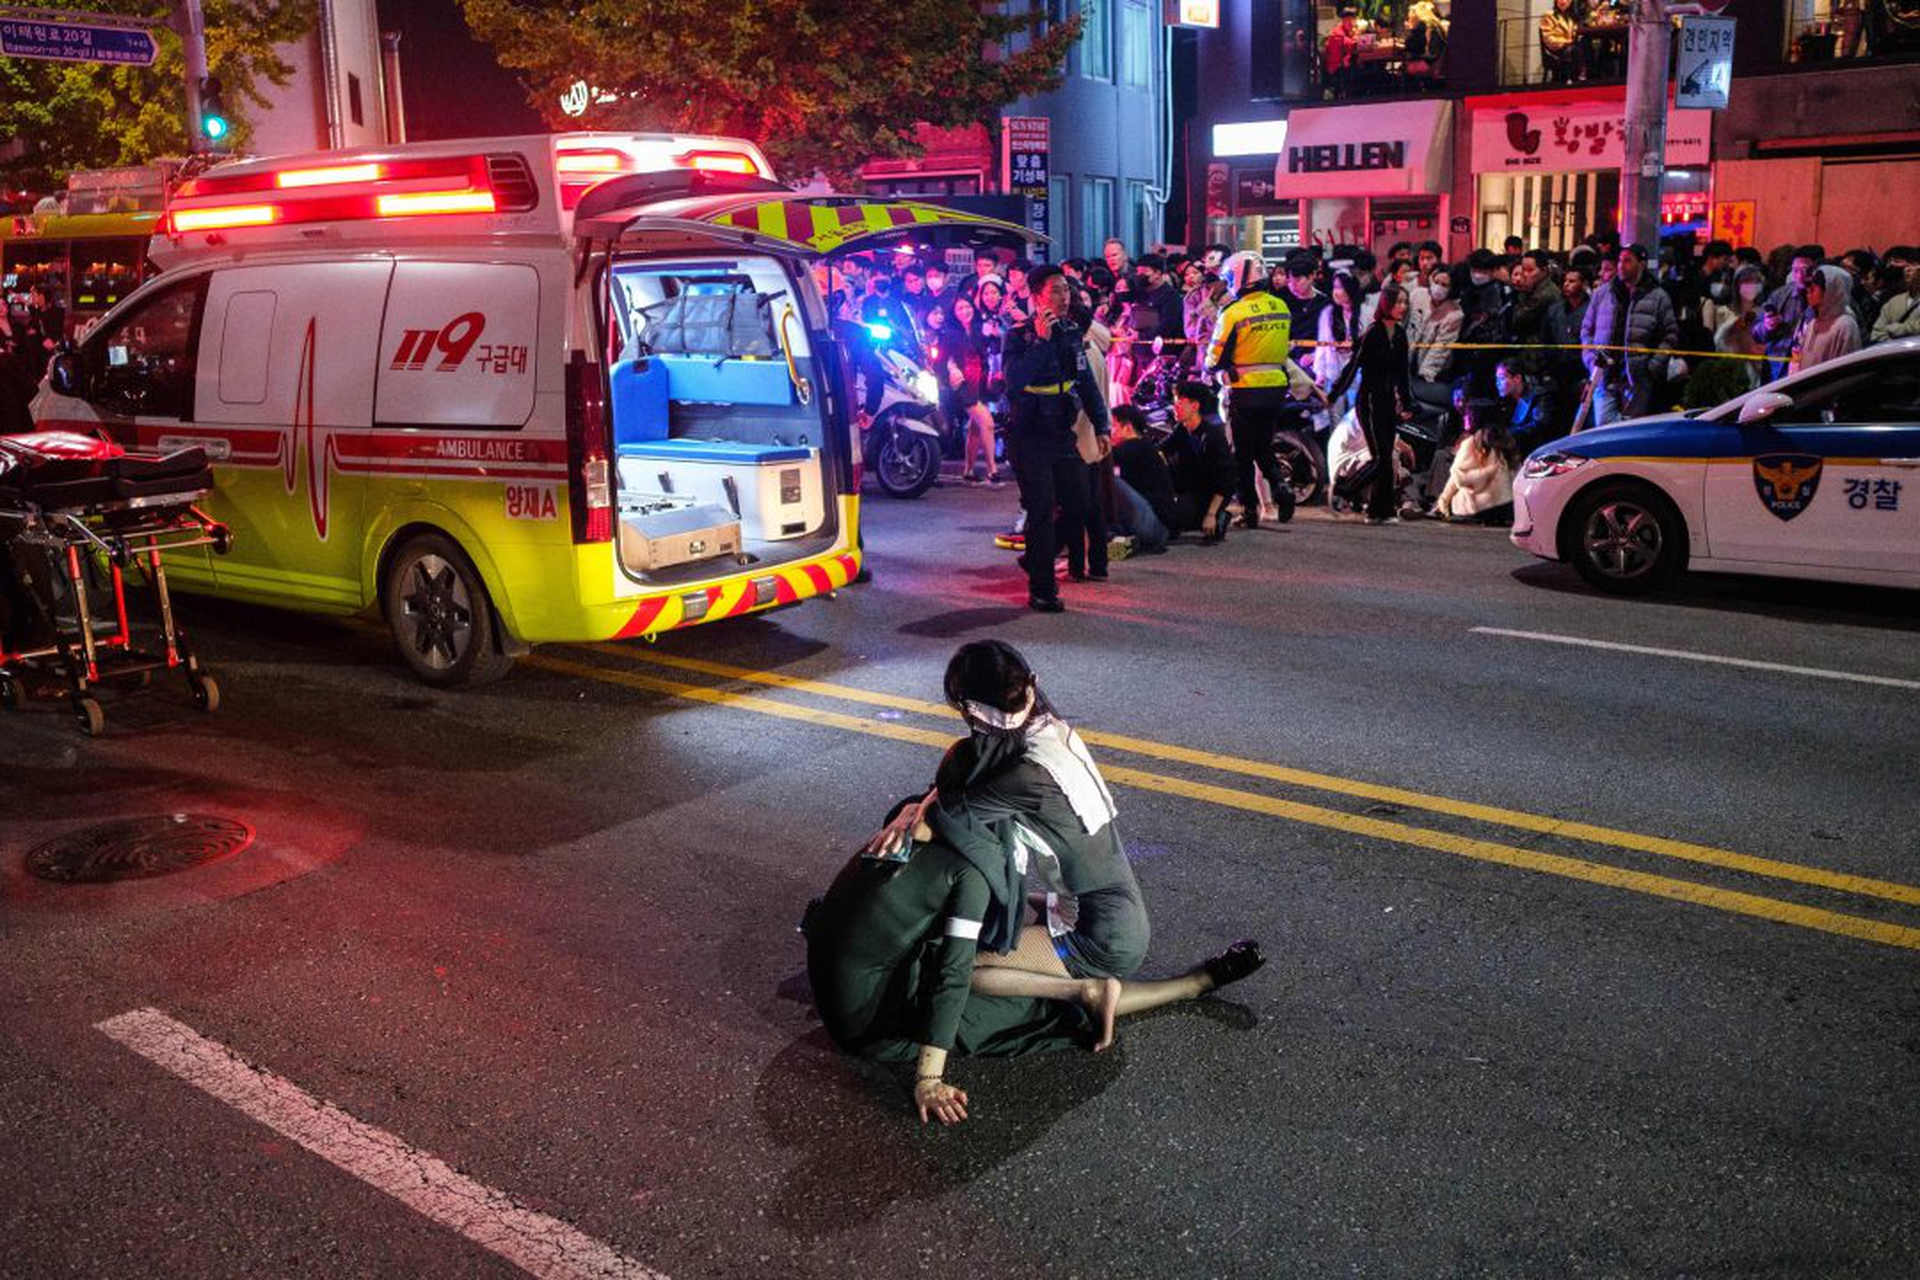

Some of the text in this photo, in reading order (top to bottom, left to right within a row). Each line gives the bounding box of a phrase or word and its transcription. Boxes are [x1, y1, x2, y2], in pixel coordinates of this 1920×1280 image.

[1289, 141, 1404, 173] HELLEN
[390, 311, 527, 374] 119 구급대
[437, 440, 524, 461] AMBULANCE
[1843, 479, 1902, 511] 경찰
